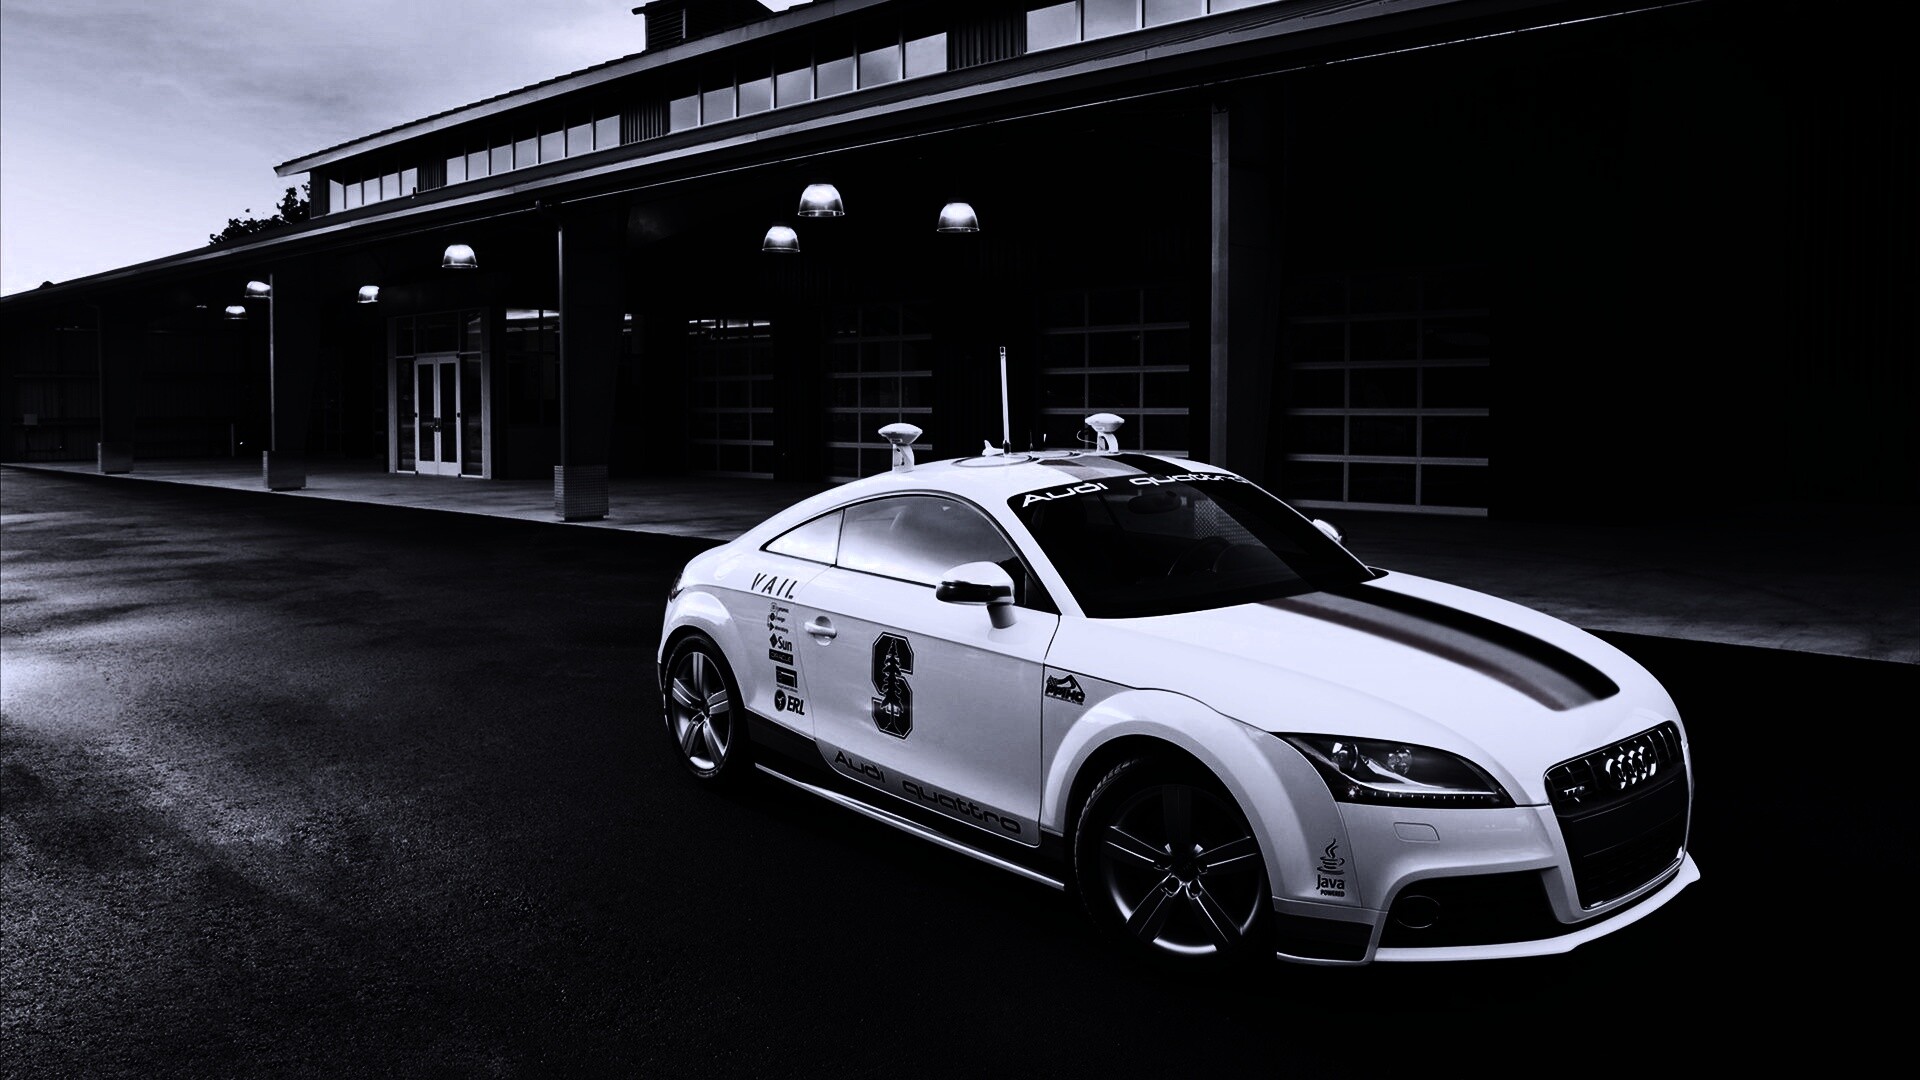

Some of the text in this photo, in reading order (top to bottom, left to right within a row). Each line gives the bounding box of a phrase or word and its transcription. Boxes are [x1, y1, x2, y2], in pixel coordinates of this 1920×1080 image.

[1022, 482, 1109, 508] Audi
[751, 572, 798, 600] VAIL
[777, 635, 792, 652] Sun
[786, 695, 806, 716] ERL
[834, 750, 1022, 834] Audi quattro
[1315, 874, 1345, 890] Java
